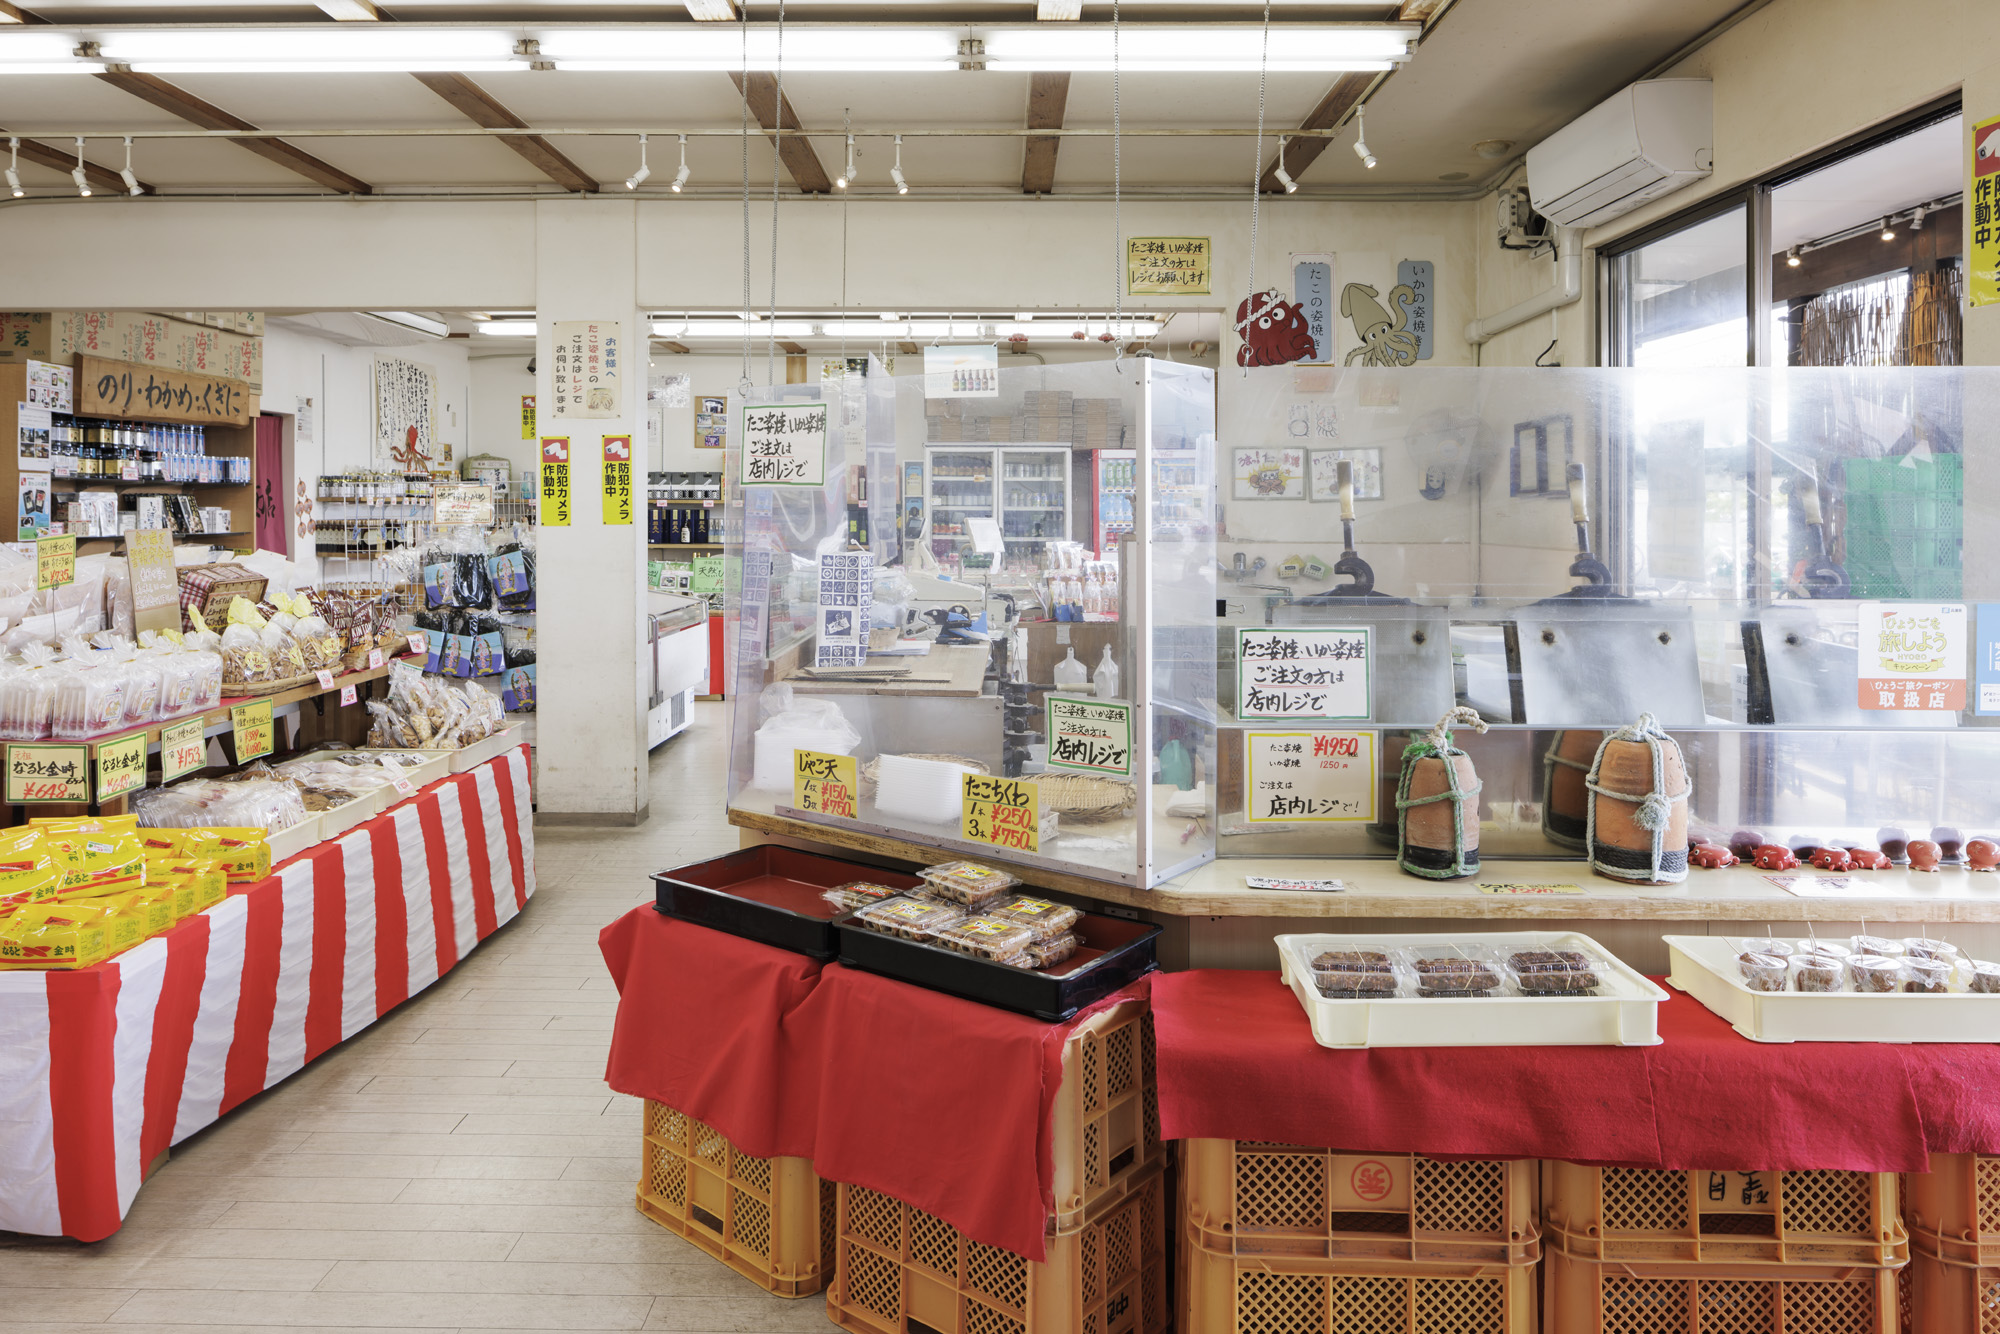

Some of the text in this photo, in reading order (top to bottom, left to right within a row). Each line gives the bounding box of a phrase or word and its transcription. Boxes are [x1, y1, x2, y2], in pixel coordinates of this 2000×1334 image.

[1975, 178, 1991, 249] 作動中
[1139, 256, 1196, 268] ご注文の方は
[1132, 270, 1204, 285] レジでお願いします
[1310, 268, 1324, 351] たこの姿焼き
[1412, 265, 1426, 347] いかの姿焼き
[588, 324, 599, 384] たこ姿焼きの
[605, 337, 616, 378] お客様へ
[555, 344, 567, 414] お伺い致します
[572, 334, 583, 404] ご注文はレジで
[97, 371, 241, 417] のり・わかめ・くぎに
[750, 438, 792, 457] ご注文は
[605, 463, 616, 497] 作動中
[748, 458, 809, 480] 店内レジで
[543, 464, 555, 499] 作動中
[556, 464, 568, 521] 防犯カメラ
[618, 462, 630, 520] 防犯カメラ
[1883, 617, 1941, 630] ひょうごを
[1878, 630, 1948, 653] 旅しよう
[1254, 665, 1345, 685] ご注文の方は
[1874, 681, 1950, 690] ひょうご旅クーポン
[1245, 686, 1327, 712] 店内レジで
[1879, 691, 1945, 708] 取扱店
[1054, 704, 1126, 721] たこ姿焼・いか姿焼
[1059, 721, 1107, 737] ご注文の方は
[14, 750, 32, 760] 元祖
[177, 746, 201, 769] ¥153
[1052, 736, 1127, 765] 店内レジで
[1270, 743, 1302, 753] たこ姿焼
[13, 760, 78, 777] なると金時
[102, 749, 140, 772] なると金時
[799, 753, 842, 782] じゃこ天
[1269, 758, 1301, 768] いか姿焼
[1320, 760, 1339, 769] 1250
[23, 782, 68, 800] ¥648
[106, 773, 130, 795] ¥648
[804, 780, 817, 793] 1枚
[822, 782, 847, 801] ¥150
[965, 776, 1029, 806] たこちくわ
[1259, 780, 1293, 790] ご注文は
[803, 795, 817, 810] 5枚
[822, 798, 851, 817] ¥750
[970, 802, 986, 816] 1本
[991, 804, 1032, 829] ¥250
[968, 819, 987, 839] 3本
[990, 824, 1030, 850] ¥750
[124, 863, 142, 875] 金時
[236, 862, 254, 871] 金時
[64, 873, 89, 885] なると
[36, 886, 55, 899] 金時
[2, 946, 21, 956] なると
[54, 945, 75, 956] 金時
